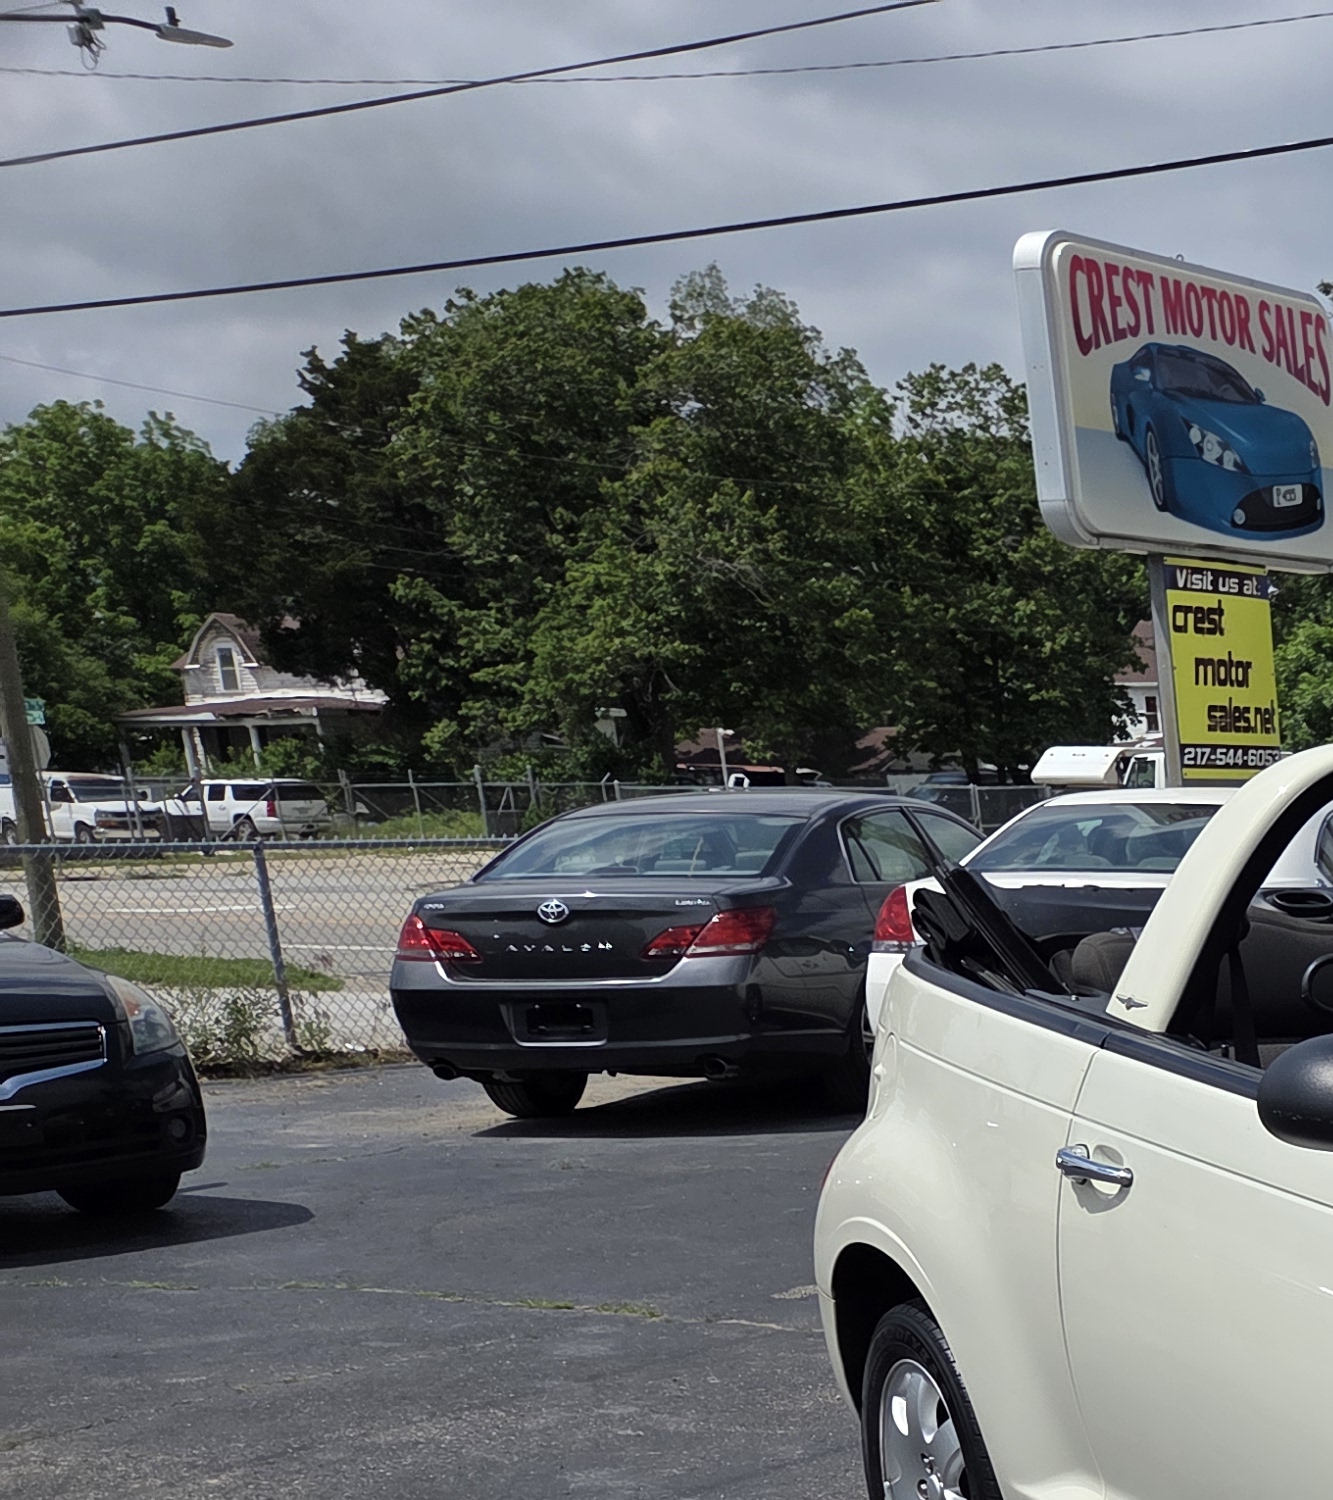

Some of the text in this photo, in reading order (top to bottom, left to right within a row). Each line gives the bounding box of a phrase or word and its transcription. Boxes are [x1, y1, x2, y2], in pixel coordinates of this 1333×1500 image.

[1069, 254, 1331, 407] CREST MOTOR SALES
[1175, 568, 1214, 591] Visit
[1218, 576, 1239, 593] us
[1172, 598, 1225, 636] crest
[1194, 650, 1252, 688] motor
[1207, 696, 1276, 735] sales.net
